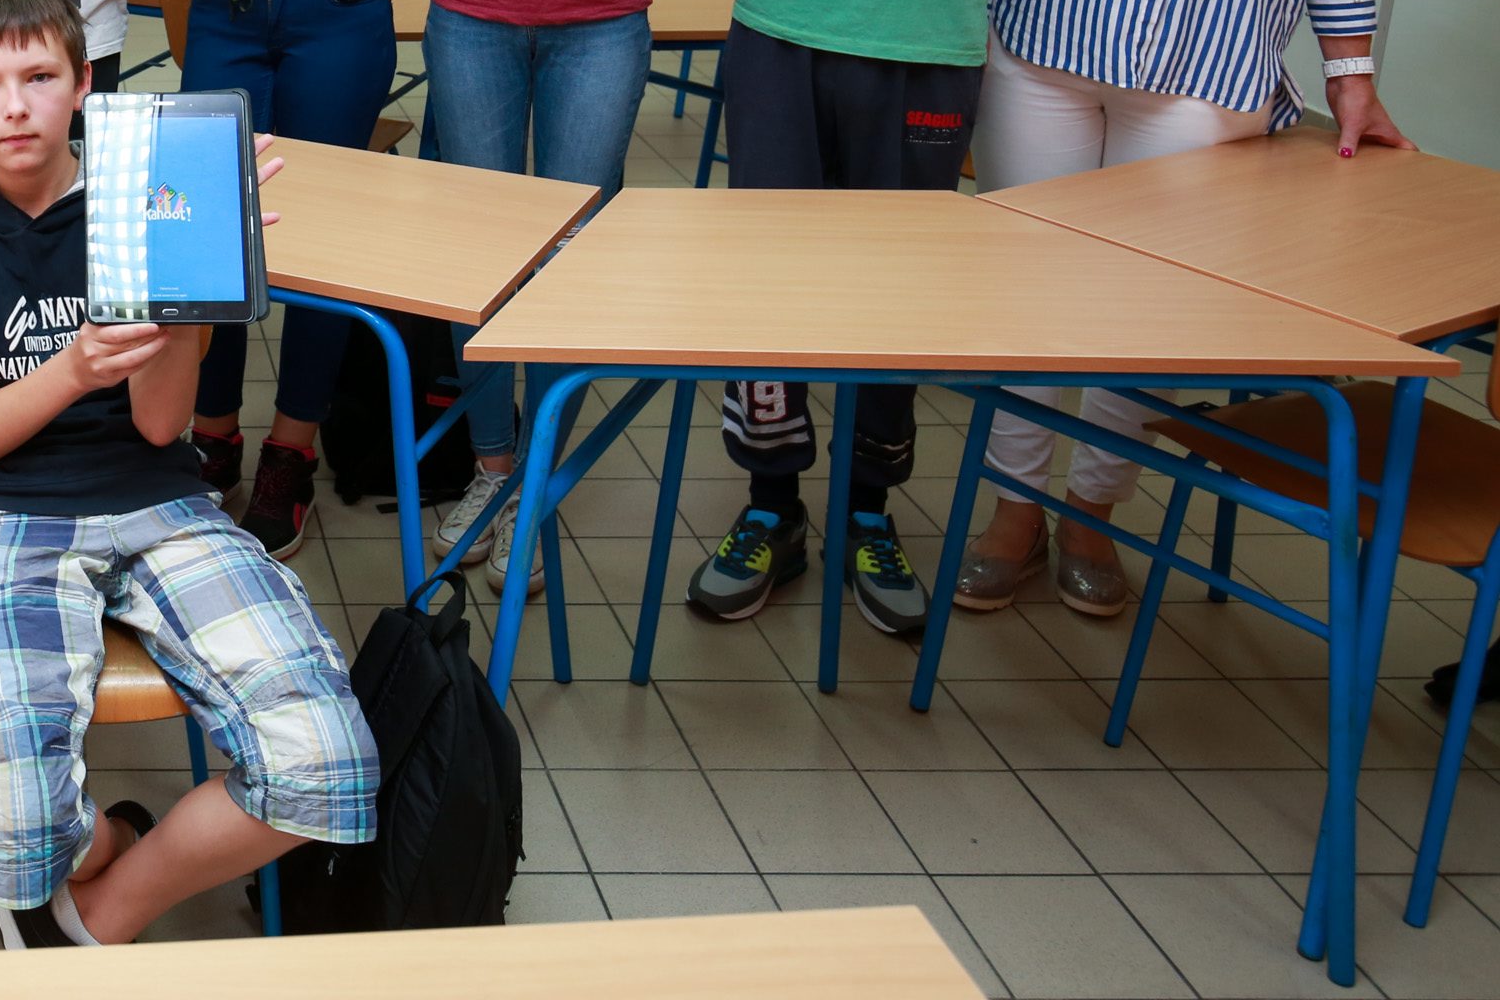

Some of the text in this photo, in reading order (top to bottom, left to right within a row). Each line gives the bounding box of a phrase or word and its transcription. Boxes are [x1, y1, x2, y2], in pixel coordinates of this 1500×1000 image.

[142, 206, 192, 222] Kahoot!
[4, 295, 38, 353] Go
[23, 336, 53, 353] UNITED
